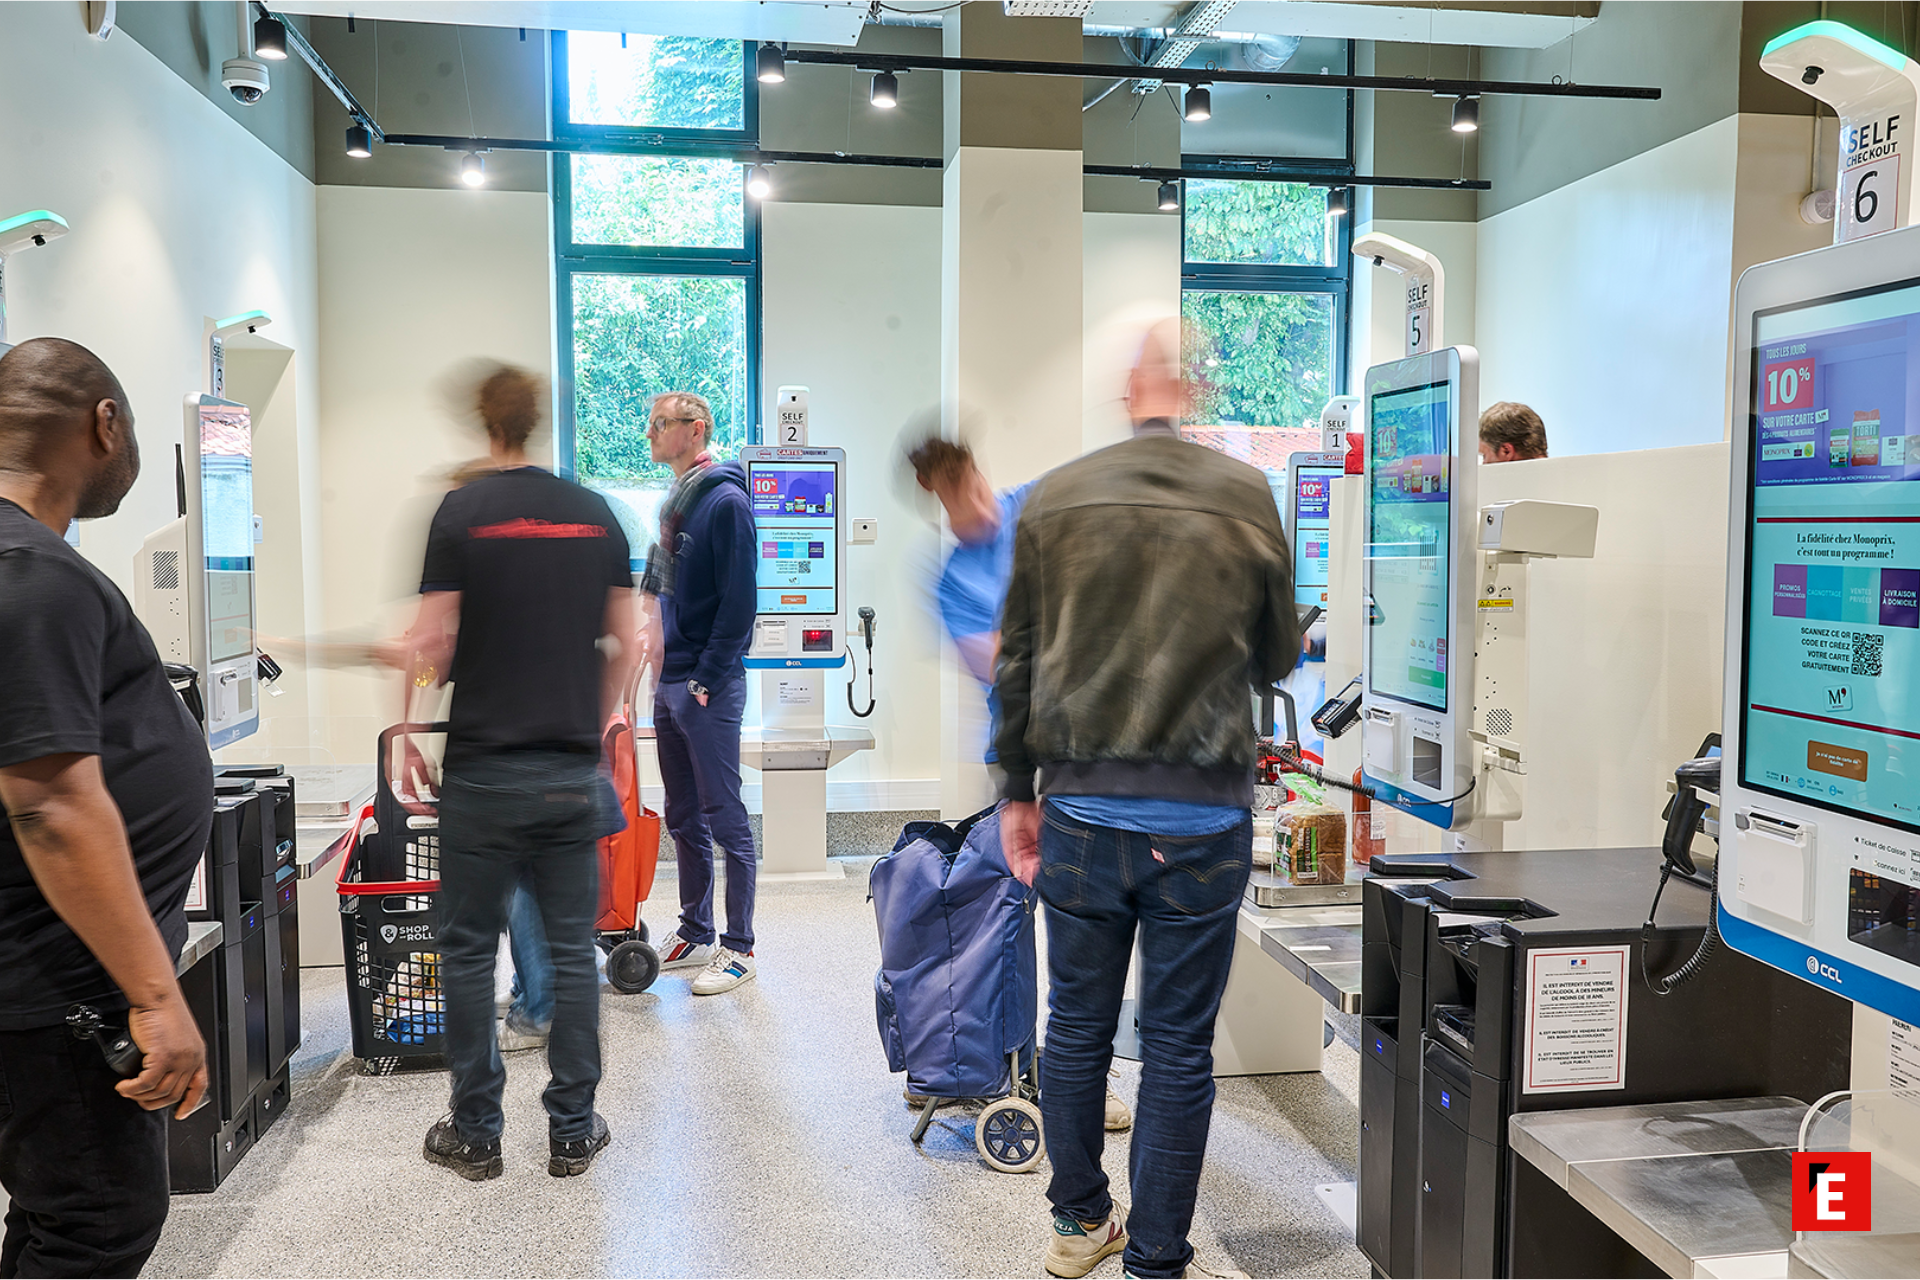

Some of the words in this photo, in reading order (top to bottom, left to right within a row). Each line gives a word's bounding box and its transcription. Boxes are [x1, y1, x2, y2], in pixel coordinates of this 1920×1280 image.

[1847, 115, 1900, 154] SELF
[1846, 141, 1898, 167] CHECKOUT
[1855, 170, 1878, 223] 6
[1408, 284, 1428, 304] SELF
[1411, 316, 1421, 346] 5
[1766, 348, 1780, 359] TOUS
[1780, 346, 1789, 357] LES
[1790, 344, 1806, 356] JOURS
[1768, 367, 1810, 405] 10%
[782, 412, 803, 420] SELF
[1763, 417, 1774, 428] SUR
[1775, 414, 1794, 427] VOTRE
[1795, 413, 1814, 426] CARTE
[787, 426, 798, 442] 2
[1332, 434, 1340, 447] 1
[1797, 534, 1806, 543] La
[1807, 533, 1834, 544] fidélité
[1835, 534, 1851, 544] chez
[1796, 548, 1813, 557] c'est
[1814, 549, 1830, 558] tout
[1842, 550, 1889, 561] programme
[1808, 589, 1841, 598] CAGNOTTAGE
[1884, 590, 1916, 598] LIVRAISON
[1888, 598, 1917, 607] DOMICILE
[1801, 627, 1829, 637] SCANNEZ
[1831, 630, 1840, 638] CE
[1841, 631, 1851, 639] QR
[1829, 640, 1850, 650] CRÉEZ
[1808, 651, 1827, 659] VOTRE
[1828, 652, 1850, 662] CARTE
[1802, 661, 1850, 674] GRATUITEMENT
[1861, 838, 1877, 848] Ticket
[1887, 845, 1906, 857] Caisse
[400, 925, 429, 933] SHOP
[407, 932, 434, 941] ROLL
[1820, 964, 1843, 984] CCL
[1055, 1221, 1073, 1232] VEJA
